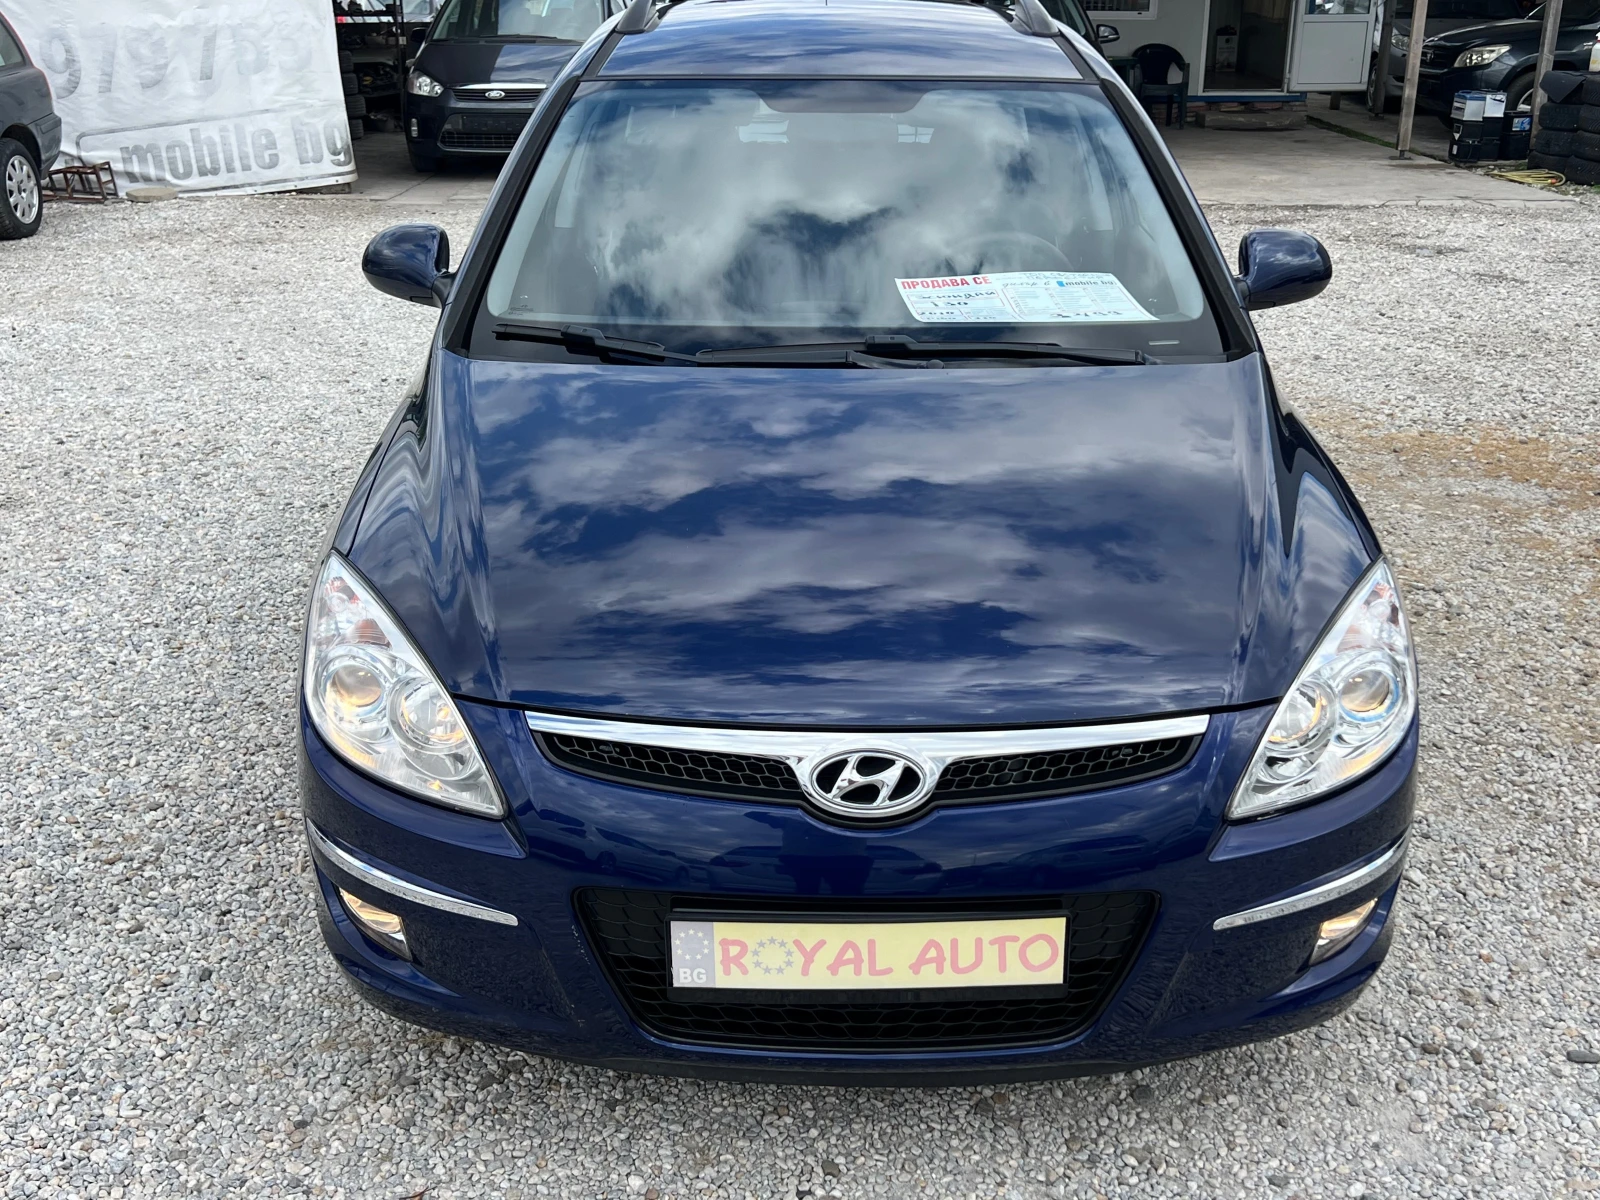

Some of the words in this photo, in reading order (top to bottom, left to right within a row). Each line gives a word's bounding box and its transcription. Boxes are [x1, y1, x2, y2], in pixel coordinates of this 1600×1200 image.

[120, 124, 279, 184] mobile
[293, 118, 353, 167] bg
[901, 278, 970, 289] ПРОДАВА
[972, 276, 992, 285] СЕ
[718, 937, 894, 977] ROYAL
[908, 933, 1060, 976] AUTO
[678, 967, 707, 984] BG
